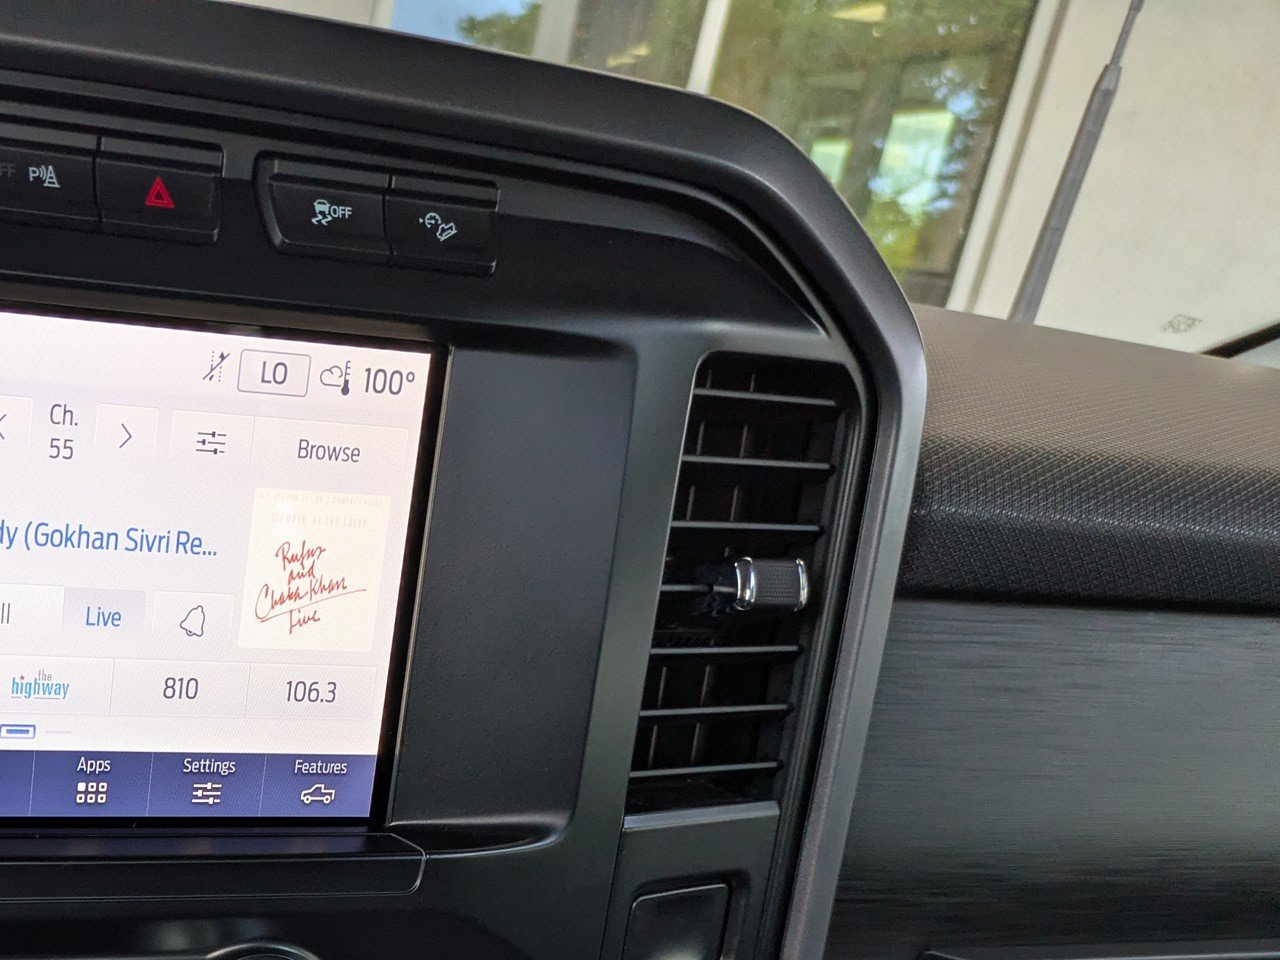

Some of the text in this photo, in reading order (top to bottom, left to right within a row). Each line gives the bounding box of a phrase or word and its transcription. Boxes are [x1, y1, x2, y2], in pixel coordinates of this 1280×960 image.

[330, 205, 352, 219] OFF
[260, 360, 288, 386] LO
[364, 366, 416, 396] 100°
[49, 403, 79, 427] Ch.
[48, 437, 75, 460] 55
[297, 437, 361, 464] Browse
[23, 521, 119, 552] (Gokhan
[124, 527, 171, 553] Sivri
[175, 530, 218, 556] Re...
[85, 606, 121, 628] Live
[38, 668, 52, 682] the
[10, 676, 70, 700] highway
[163, 677, 199, 700] 810
[286, 680, 337, 704] 106.3
[76, 757, 111, 774] Apps
[183, 758, 236, 775] Settings
[294, 759, 347, 775] Features
